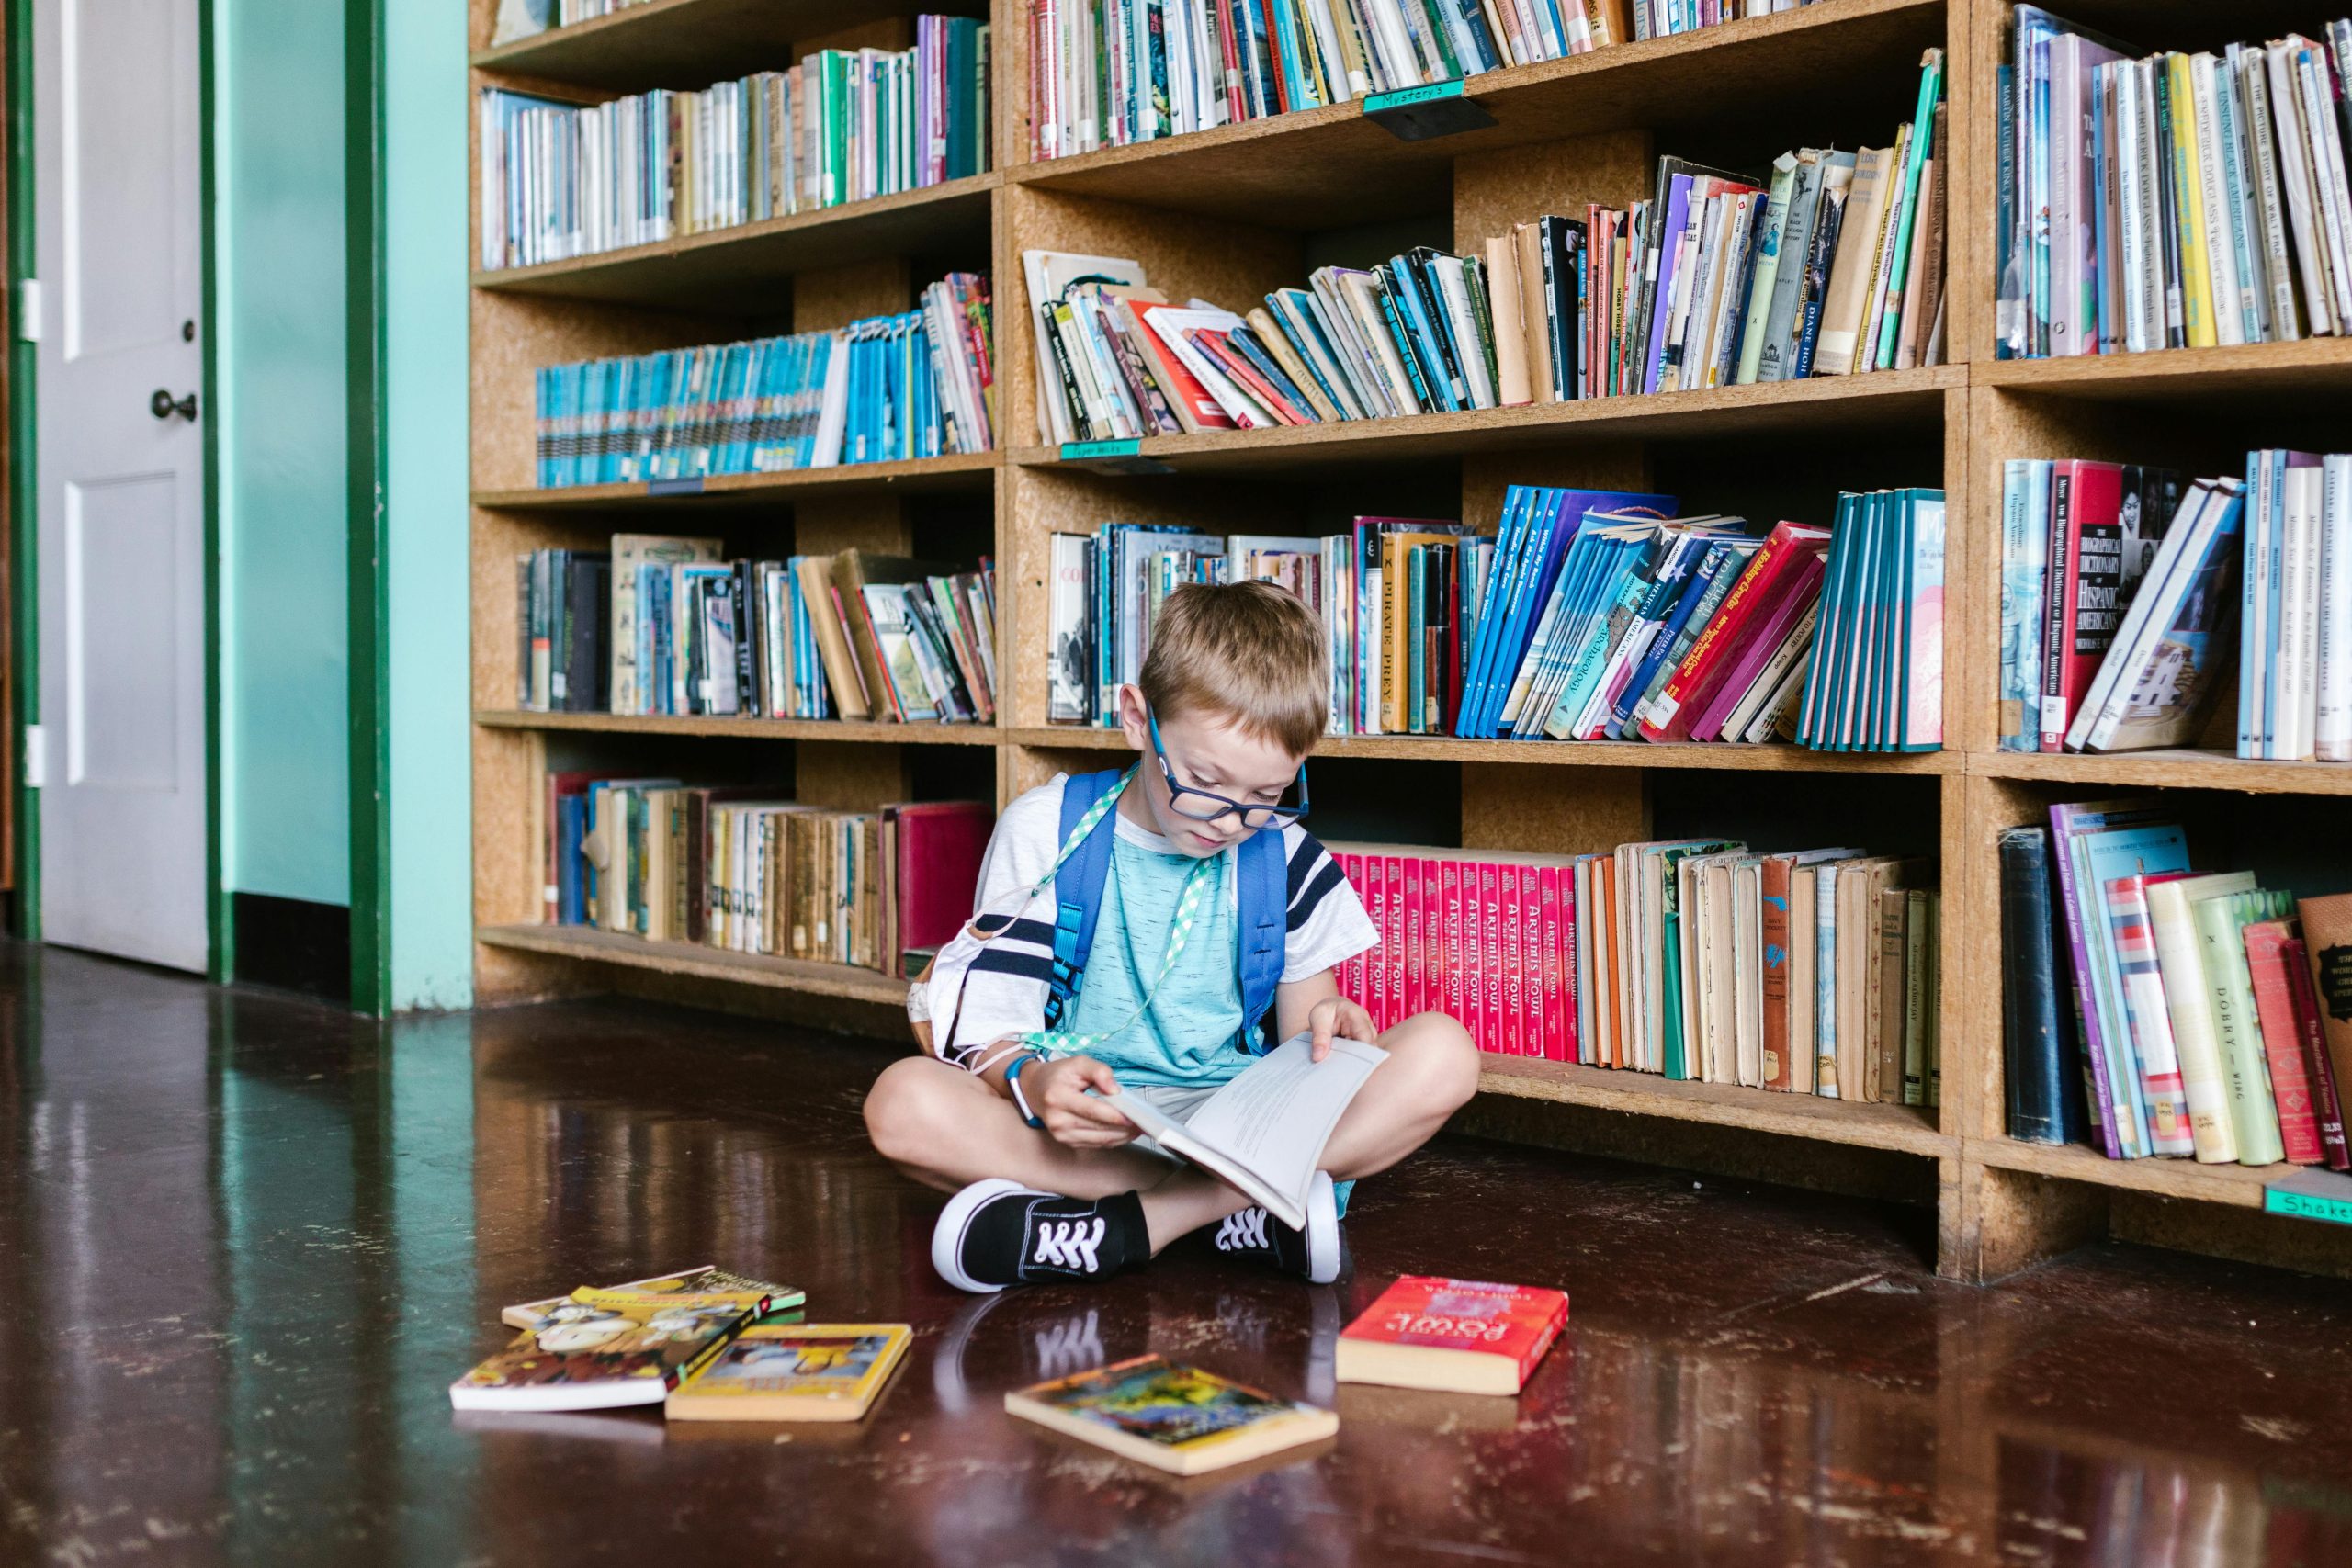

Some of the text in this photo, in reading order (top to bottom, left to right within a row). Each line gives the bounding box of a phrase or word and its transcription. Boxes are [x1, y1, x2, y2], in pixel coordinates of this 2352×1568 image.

[1381, 85, 1443, 107] Mystery's
[2003, 85, 2012, 163] MARTIN LUTHER
[1861, 154, 1878, 164] LOST
[2121, 170, 2130, 184] The
[2136, 107, 2153, 231] FREDERICK DOUGLASS
[2197, 95, 2220, 220] FREDERICK DOUGLASS
[2217, 90, 2247, 248] UNSUNG BLACK AMERICANS
[2253, 85, 2278, 229] THE PICTURE STORY OF WALT
[1868, 208, 1891, 292] Nevada Facts and Symbols
[1880, 201, 1901, 276] Texas Facts and Symbols
[1433, 322, 1446, 349] BATTERSEA
[1470, 272, 1481, 298] THROUGH
[1481, 329, 1489, 344] DOOR
[1799, 306, 1815, 372] DIANE HOH
[1499, 526, 1522, 589] Handle With Care
[1526, 528, 1551, 588] Within My Reach
[2008, 493, 2020, 558] Hispanic Americans
[2015, 502, 2025, 547] Extraordinary
[1478, 526, 1505, 620] Many People, Many Voices
[1509, 529, 1537, 615] Ask Me Again Tomorrow
[1609, 574, 1636, 621] ADVENTURES
[1616, 544, 1680, 658] BANDON MEXICAN AMERICANS
[1691, 554, 1734, 618] TO VICTORY
[1700, 582, 1727, 621] FLIGHT
[2048, 479, 2066, 694] Meyer Biographical Dictionary Hispanic Americans
[2077, 579, 2119, 608] HISPANIC
[1384, 581, 1392, 698] PIRATE PREY
[1654, 628, 1675, 662] PETER PAN
[1681, 628, 1713, 671] Kids Can Make
[1682, 547, 1771, 679] Holiday Crafts More Year-Round Crafts
[1773, 619, 1812, 671] TO POETRY Knapp
[2075, 612, 2117, 629] AMERICANS
[2054, 829, 2081, 942] Government and America
[1393, 894, 1403, 1000] ARTEMIS FOWL
[1411, 910, 1420, 953] ARTEMIS
[1430, 912, 1439, 955] ARTEMIS
[1450, 900, 1460, 1009] ARTEMIS FOWL
[1469, 900, 1480, 1009] ARTEMIS FOWL
[1487, 903, 1500, 1013] ARTEMIS FOWL
[1508, 904, 1521, 1014] ARTEMIS FOWL
[1529, 906, 1543, 1018] ARTEMIS FOWL
[1547, 921, 1558, 998] ARTEMIS FOWL
[1353, 959, 1363, 996] FOWL
[1374, 962, 1384, 999] FOWL
[2217, 988, 2244, 1100] DOBRY WING
[2307, 1019, 2336, 1115] The Merchant of Venice
